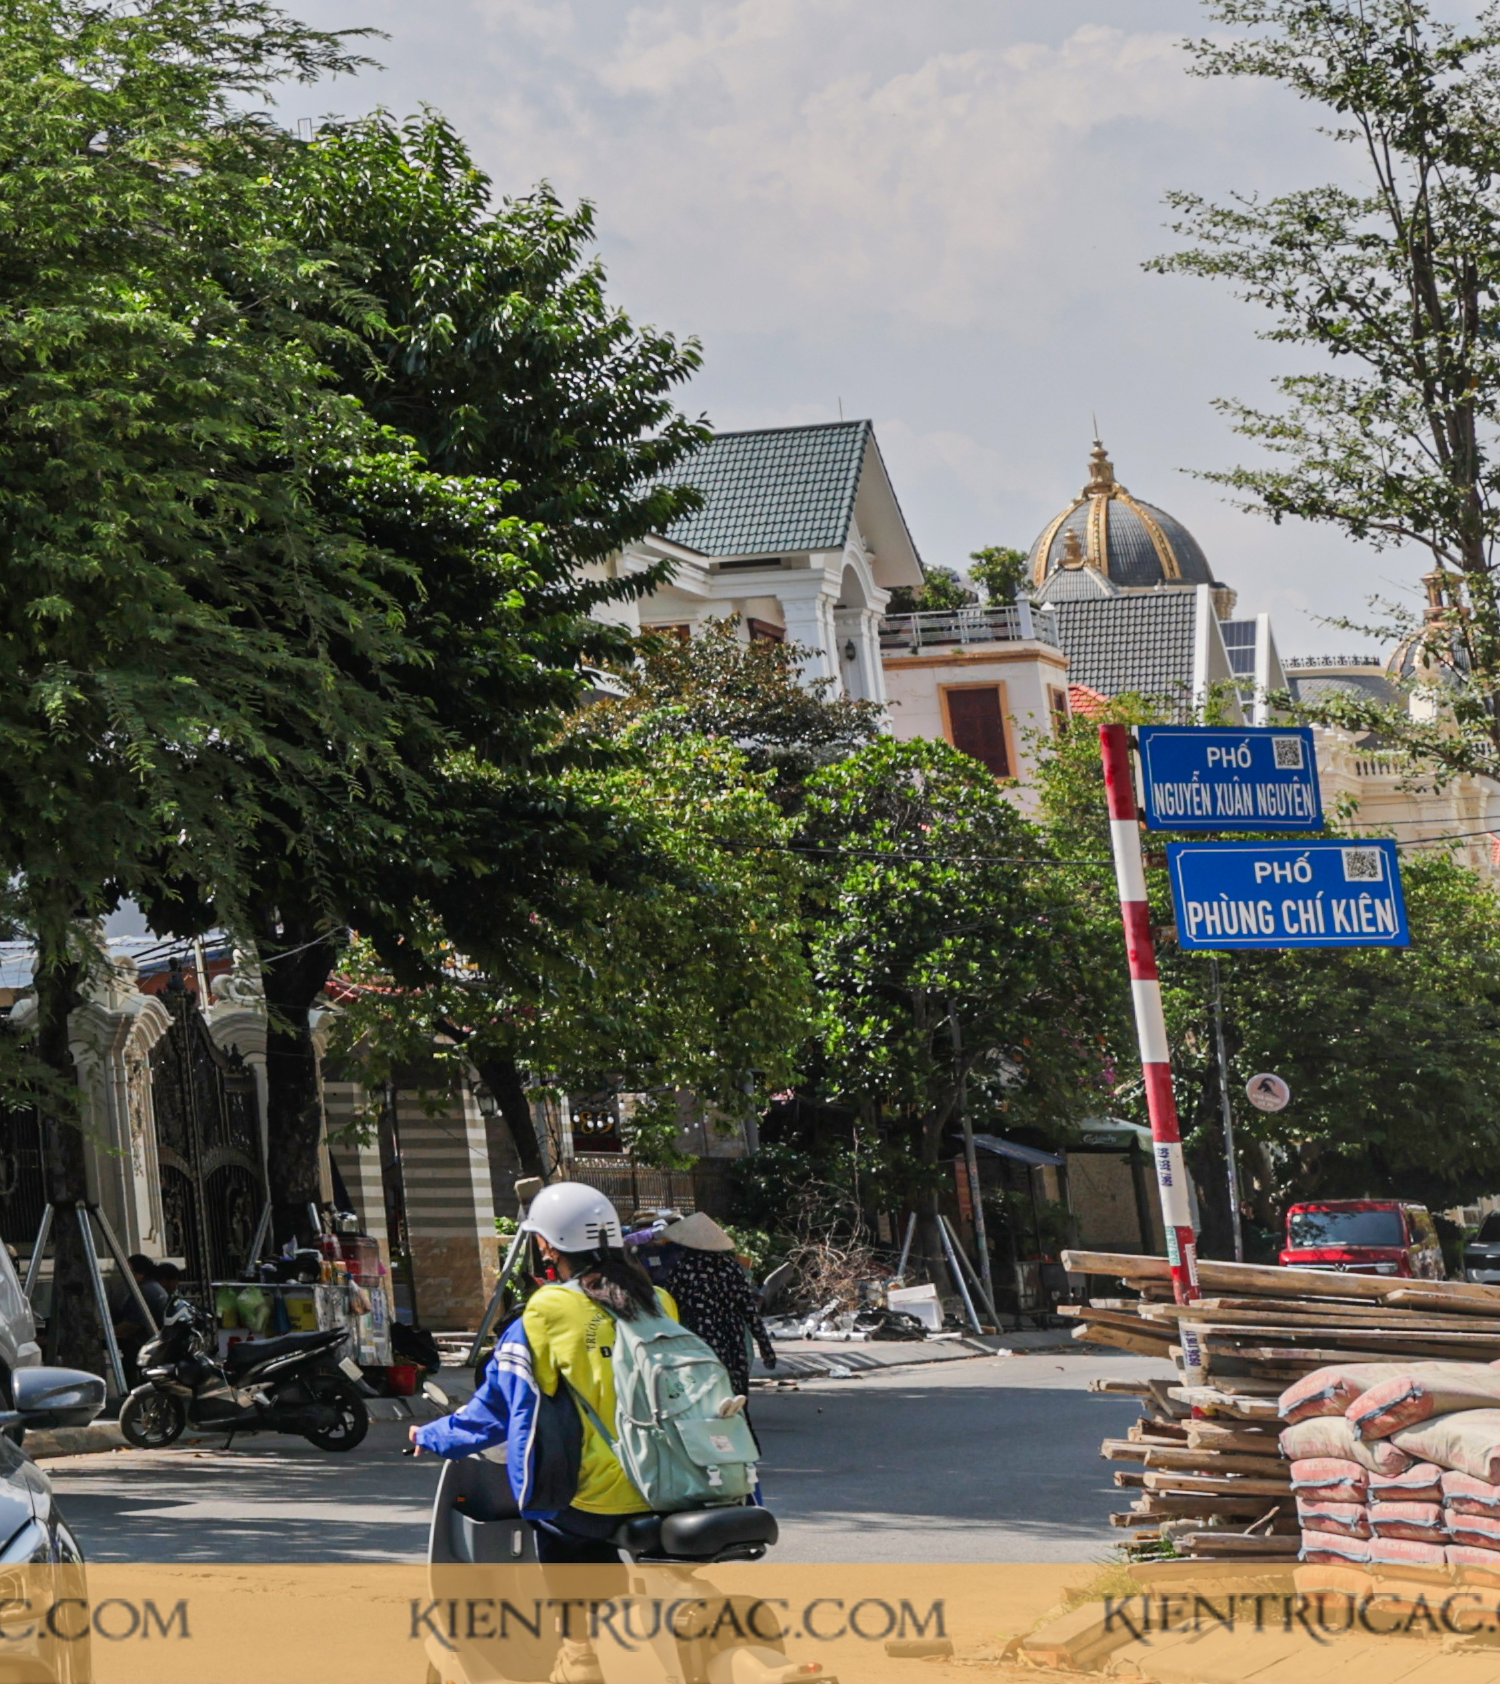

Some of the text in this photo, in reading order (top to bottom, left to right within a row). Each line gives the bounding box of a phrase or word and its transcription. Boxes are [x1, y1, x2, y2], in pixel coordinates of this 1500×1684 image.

[1206, 738, 1252, 768] PHỐ
[1153, 770, 1314, 816] NGUYỄN XUÂN NGUYÊN
[1254, 851, 1313, 884] PHỐ
[1187, 890, 1394, 936] PHÙNG CHÍ KIÊN
